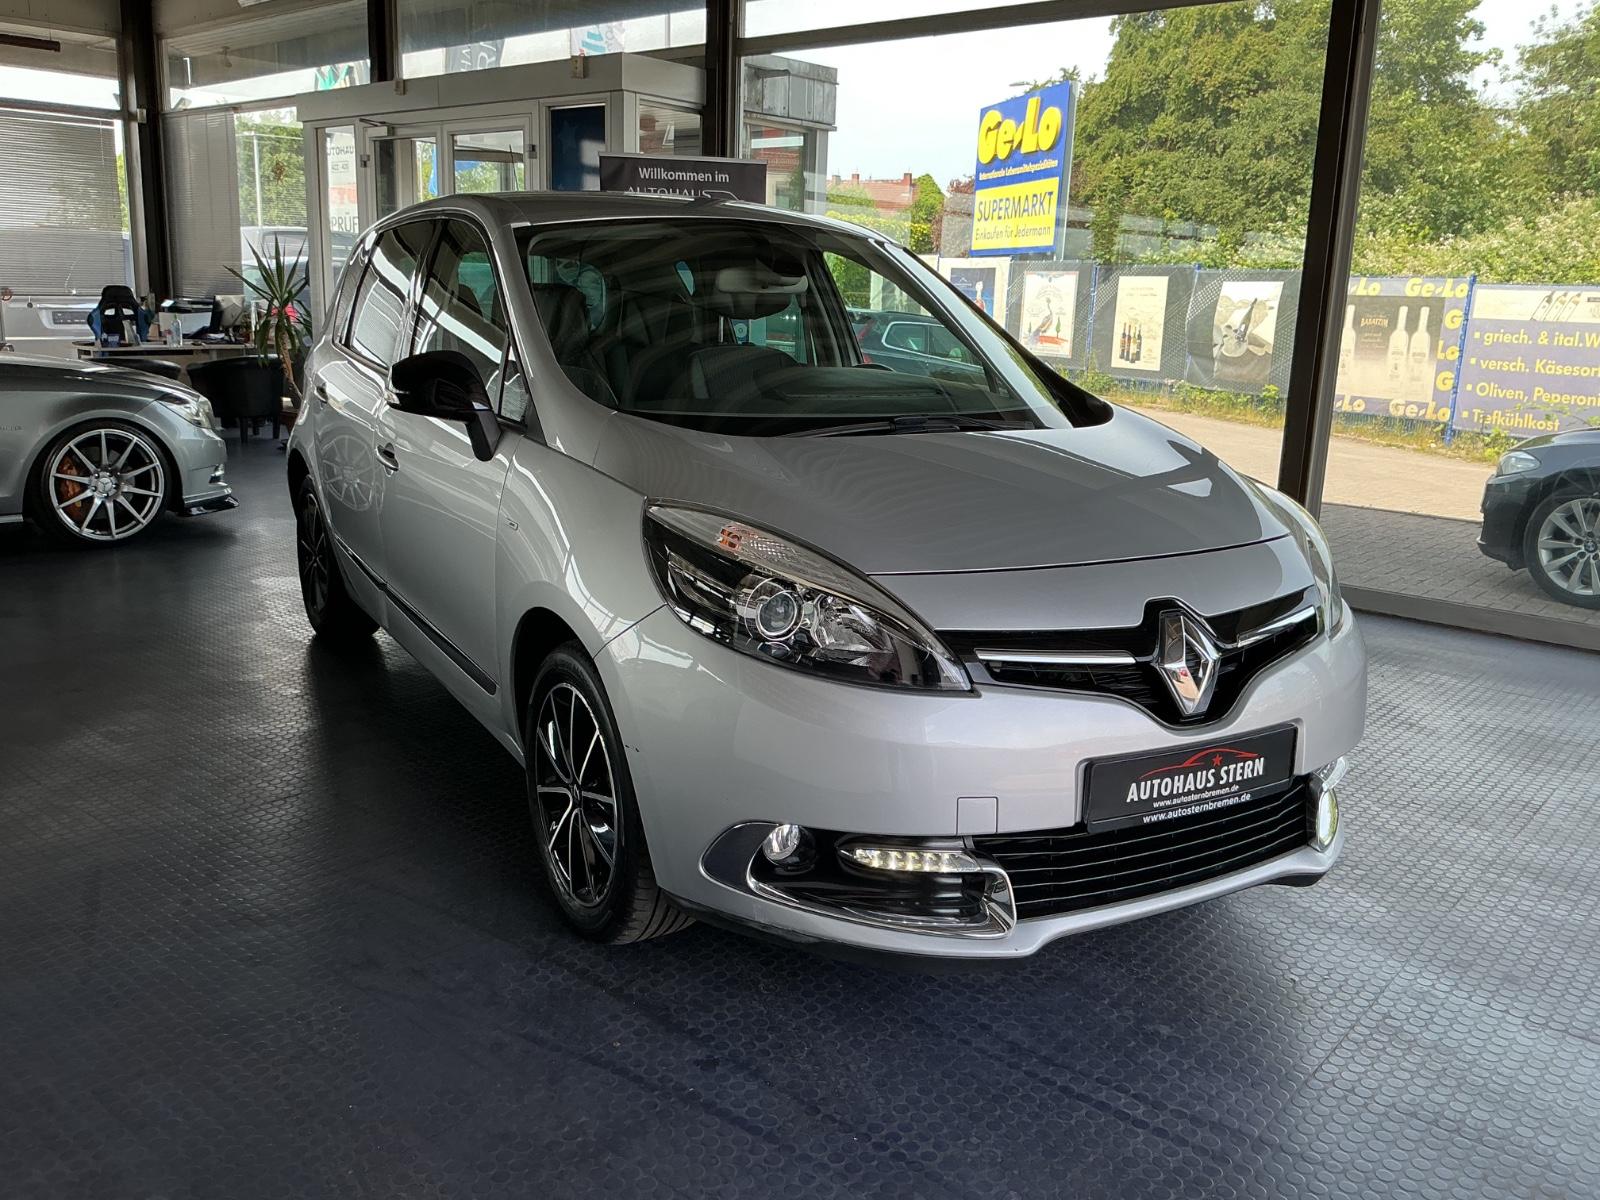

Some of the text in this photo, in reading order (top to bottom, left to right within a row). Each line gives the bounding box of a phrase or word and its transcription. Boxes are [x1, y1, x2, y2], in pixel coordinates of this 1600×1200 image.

[638, 167, 730, 183] Willkommen im
[977, 191, 1054, 222] SUPERMARKT
[975, 223, 1051, 241] Einkaufen für Jedermann
[1405, 277, 1469, 298] Ge-Lo
[1484, 328, 1533, 346] griech.
[1538, 330, 1549, 345] &
[1480, 356, 1530, 373] versch.
[1476, 382, 1529, 402] Oliven,
[1389, 398, 1451, 421] Ge-Lo
[1472, 408, 1560, 431] Tiefkühlkost
[1126, 757, 1265, 802] AUTOHAUS STERN
[1152, 784, 1239, 808] www.autosternbremen.de
[1142, 792, 1251, 824] www.autosternbremen.de
